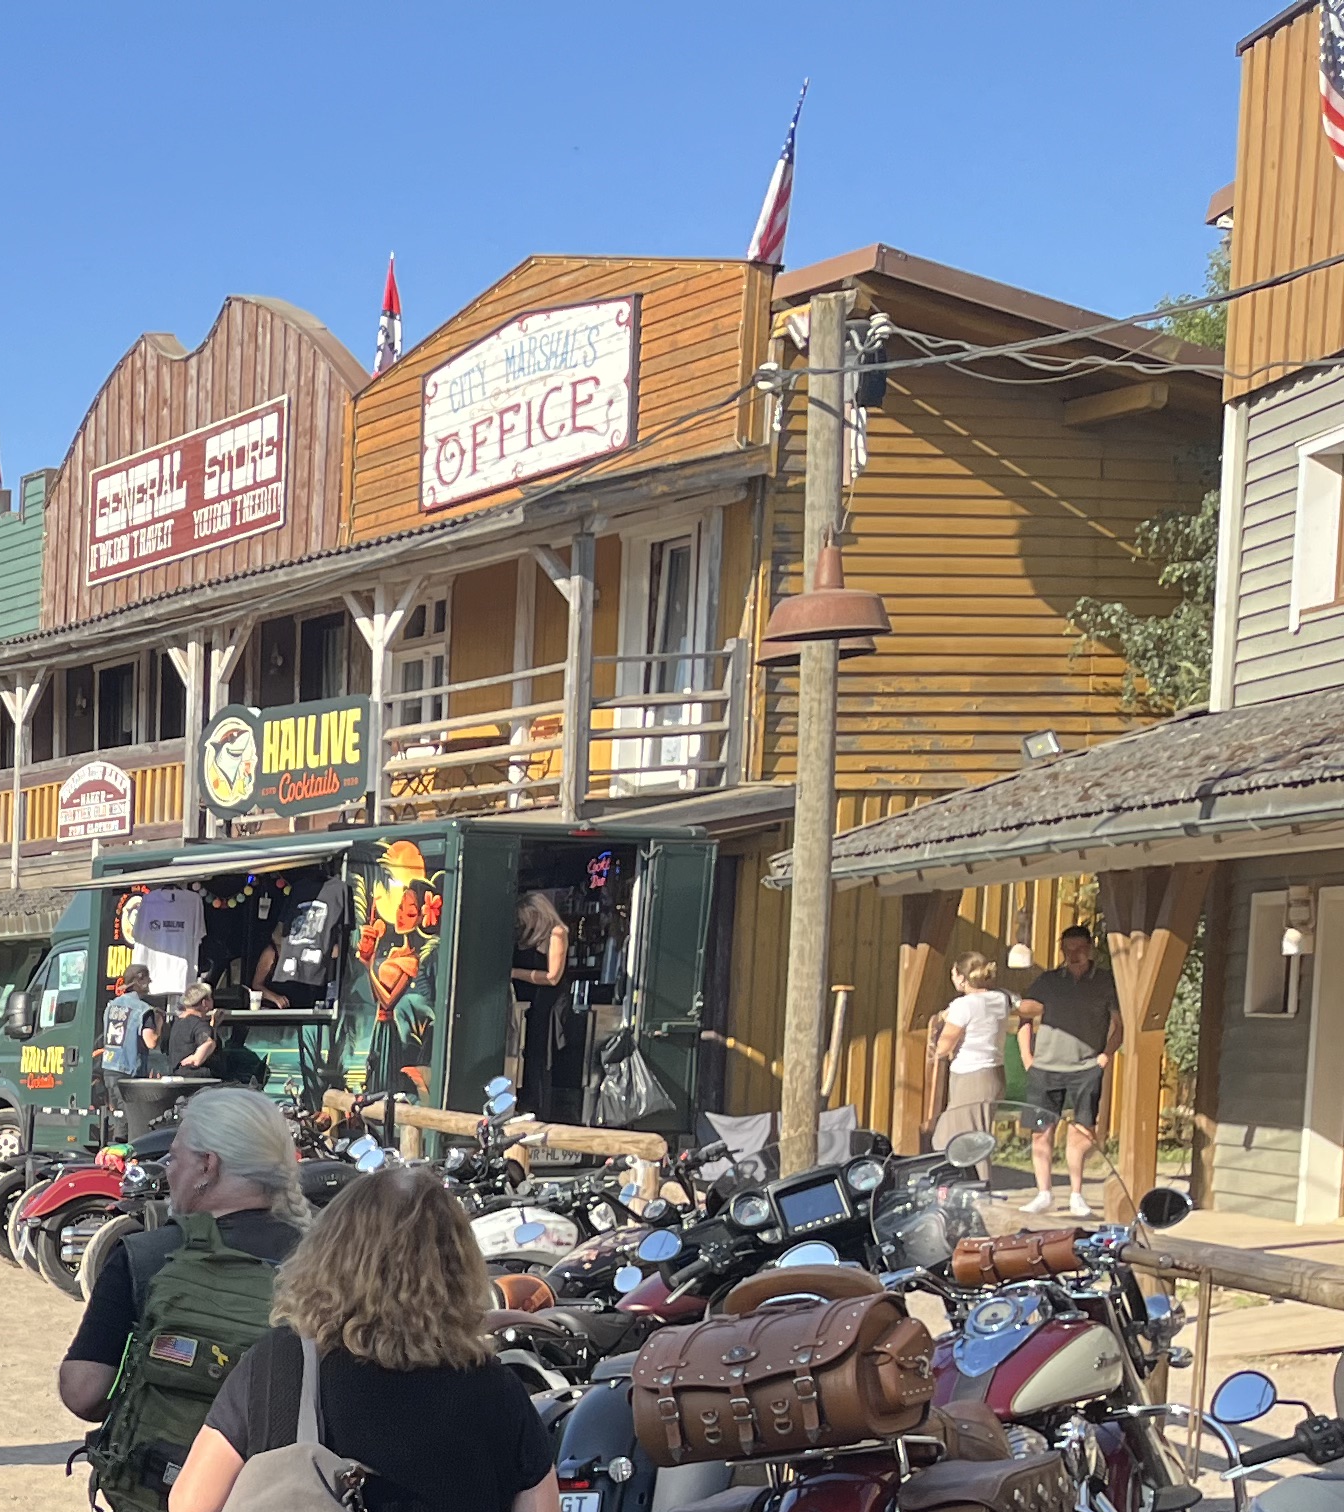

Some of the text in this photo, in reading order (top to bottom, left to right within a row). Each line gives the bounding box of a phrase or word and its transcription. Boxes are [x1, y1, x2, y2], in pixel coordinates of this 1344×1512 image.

[448, 359, 489, 415] CITY
[435, 375, 602, 487] OFFICE
[95, 411, 279, 539] GENERAL STORE
[261, 707, 363, 775] HAILIVE
[278, 767, 341, 805] Cocktails
[20, 1045, 65, 1075] HAILIVE
